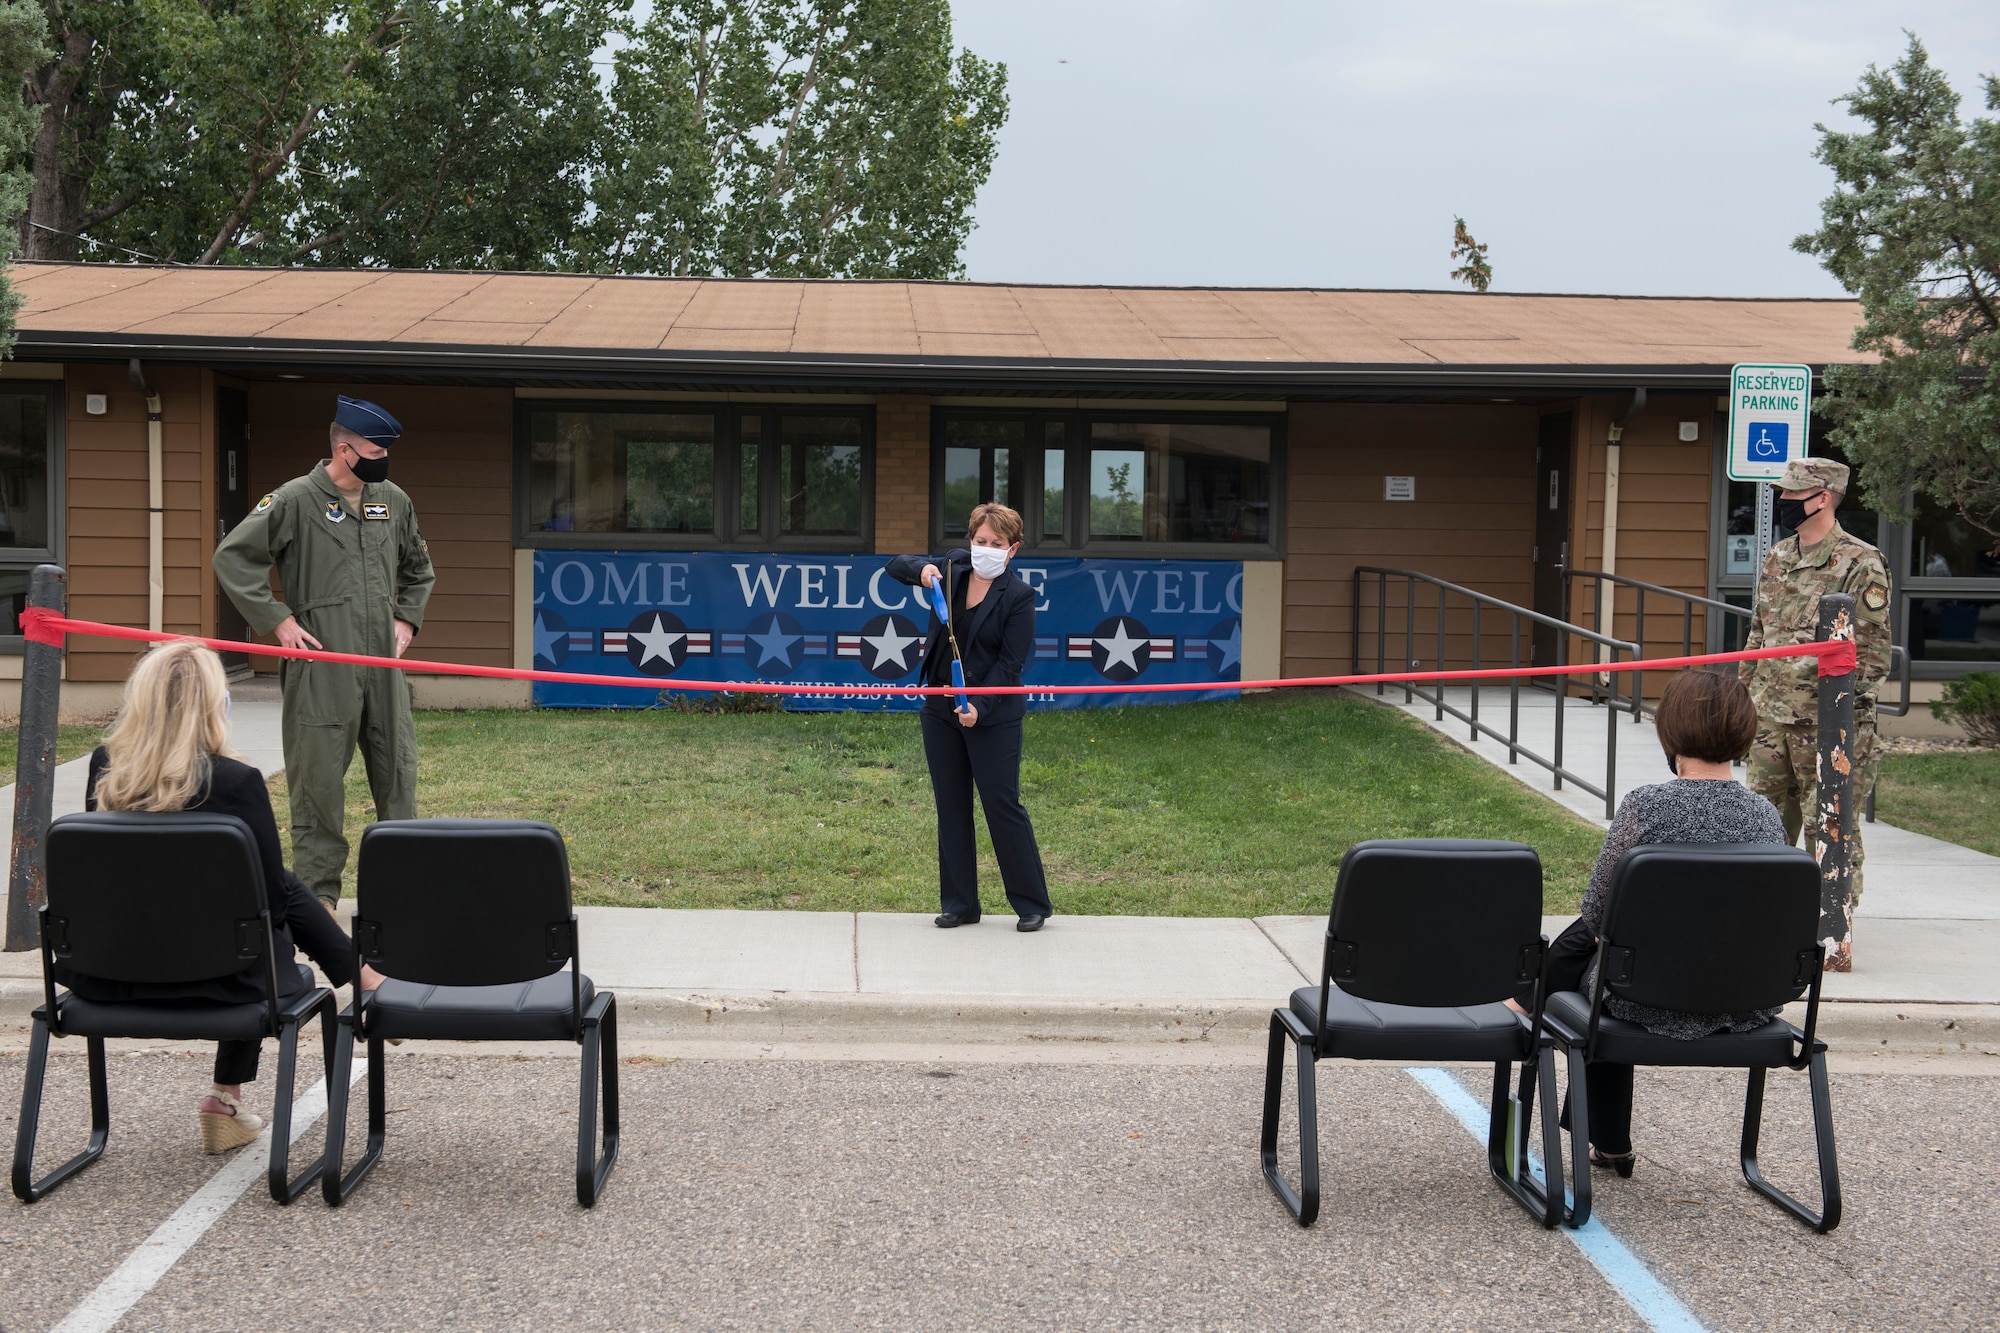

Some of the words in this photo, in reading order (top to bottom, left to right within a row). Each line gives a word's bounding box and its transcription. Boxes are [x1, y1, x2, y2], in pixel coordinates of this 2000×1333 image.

[1737, 375, 1805, 391] RESERVED
[1741, 395, 1799, 411] PARKING
[731, 563, 1050, 612] WELCE
